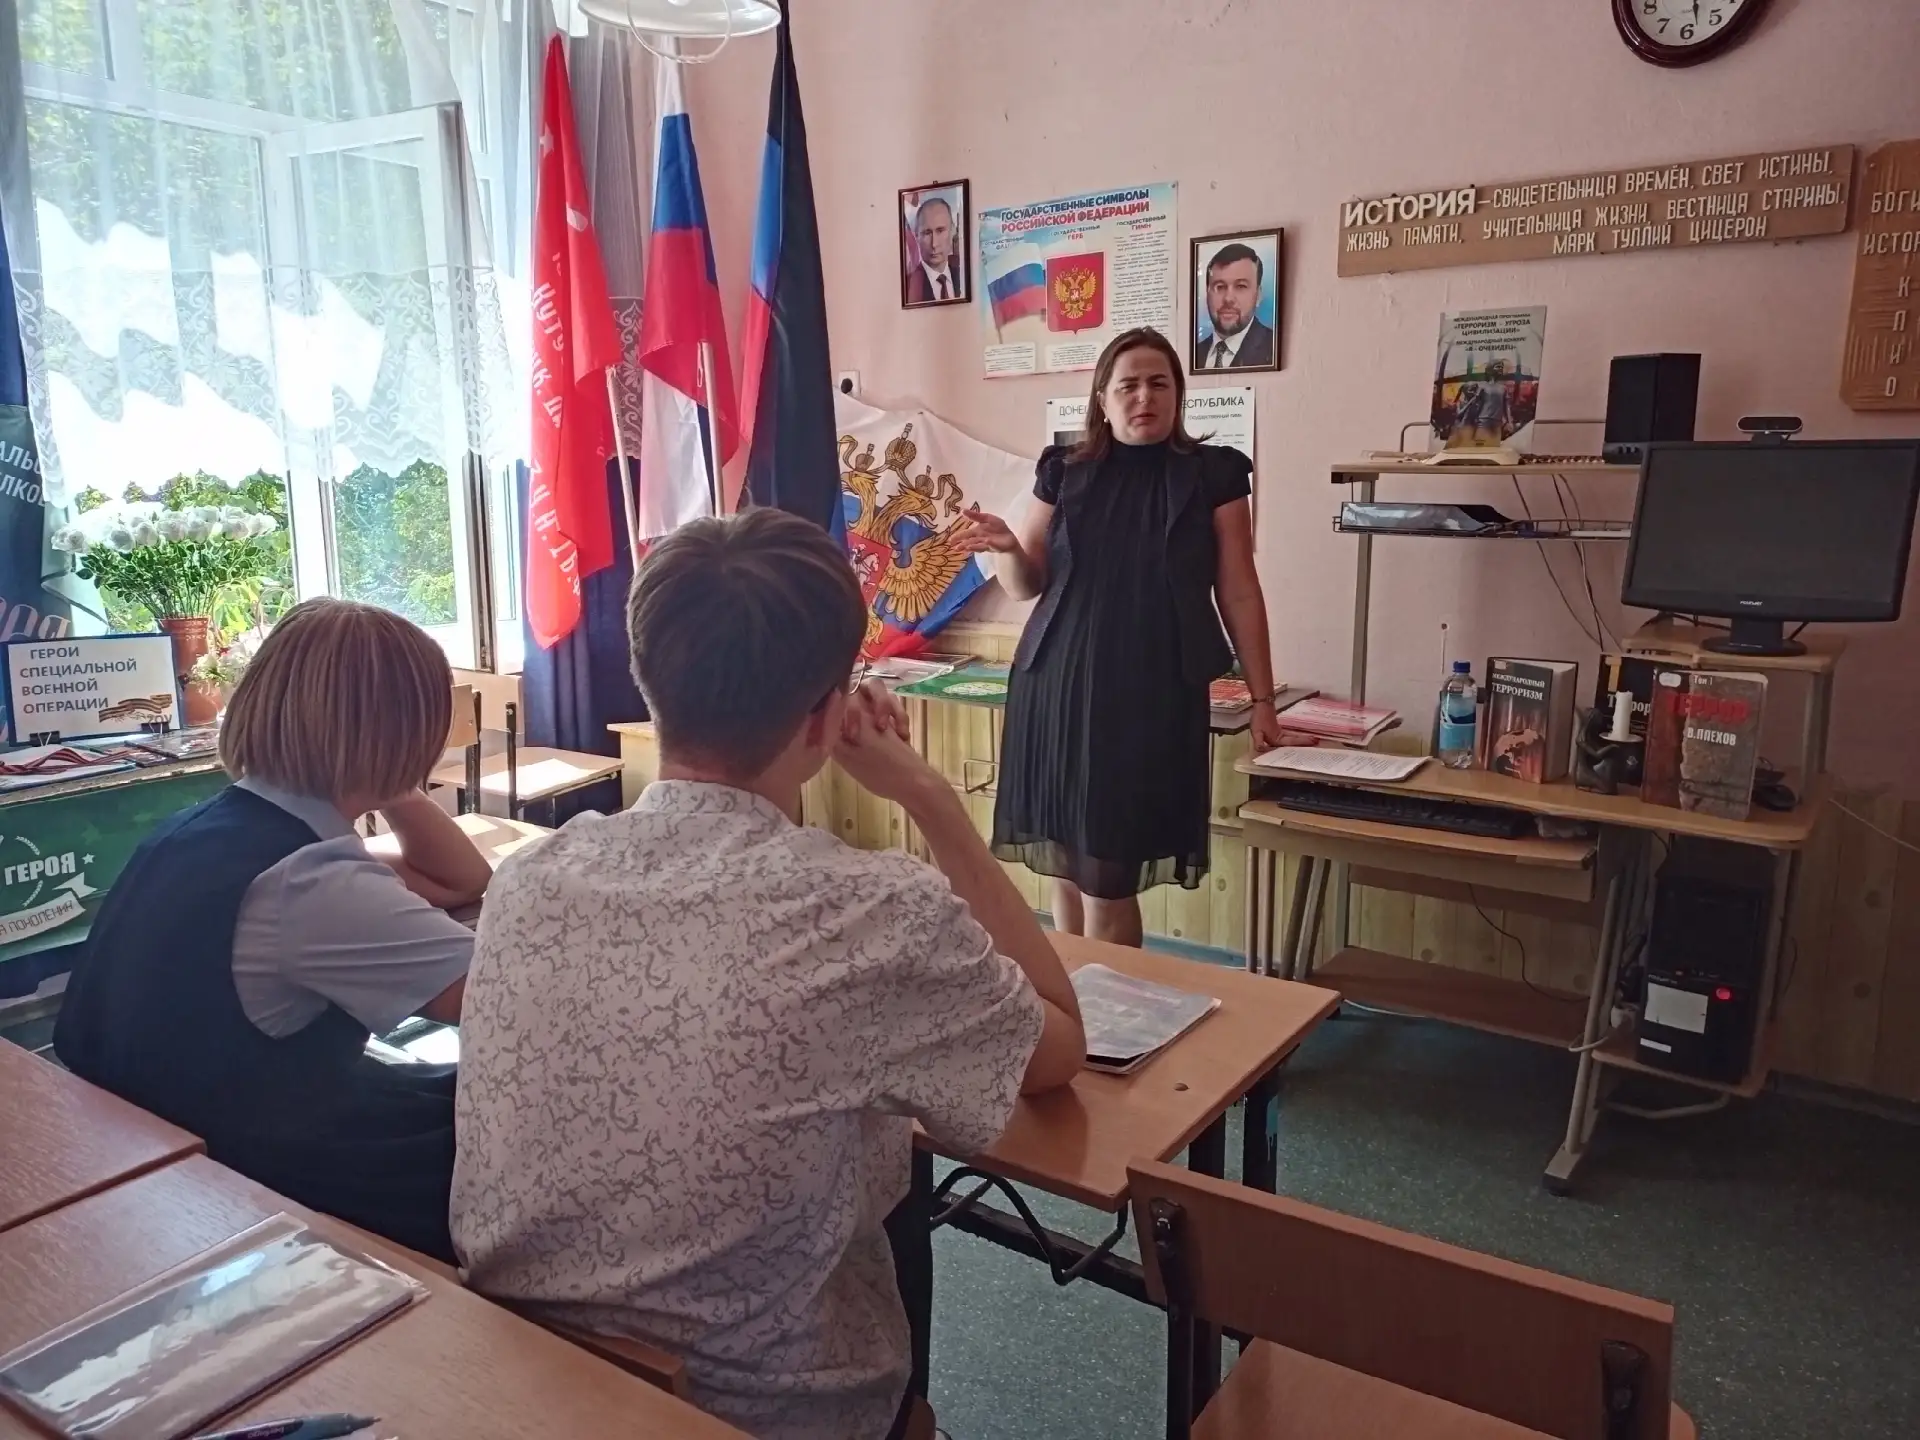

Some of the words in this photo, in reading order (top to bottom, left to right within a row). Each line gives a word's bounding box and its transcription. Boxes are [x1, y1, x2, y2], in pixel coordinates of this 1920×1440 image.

[1657, 18, 1671, 34] 7
[1709, 9, 1722, 26] 5
[1680, 23, 1694, 40] 6
[1344, 188, 1477, 228] ИСТОРИЯ
[1493, 174, 1617, 208] СВИДЕТЕЛЬНИЦА
[1625, 165, 1695, 193] ВРЕМЁН,
[1702, 162, 1744, 186] СВЕТ
[1759, 151, 1834, 179] ИСТИНЫ,
[1002, 198, 1095, 221] ГОСУДАРСТВЕННЫЕ
[1096, 189, 1149, 206] СИМВОЛЫ
[1002, 210, 1075, 234] РОССИЙСКОЙ
[1077, 201, 1150, 222] ФЕДЕРАЦИИ
[1132, 223, 1151, 231] ГИМН
[1347, 230, 1390, 252] ЖИЗНЬ
[1403, 222, 1464, 246] ПАМЯТИ,
[1483, 208, 1582, 239] УЧИТЕЛЬНИЦА
[1595, 203, 1651, 227] ЖИЗНИ,
[1667, 192, 1749, 221] ВЕСТНИЦА
[1762, 183, 1845, 211] СТАРИНЫ.
[1552, 232, 1596, 255] МАРК
[1612, 223, 1672, 249] ТУЛЛИЙ
[1689, 216, 1767, 243] ЦИЦЕРОН
[30, 647, 80, 660] ГЕРОИ
[20, 658, 137, 679] СПЕЦИАЛЬНОЙ
[22, 678, 98, 697] ВОЕННОЙ
[1492, 672, 1545, 688] МЕЖДУНАРОДНЫЙ
[1693, 675, 1707, 685] Том
[1492, 682, 1543, 701] ТЕРРОРИЗМ
[23, 697, 109, 714] ОПЕРАЦИИ
[4, 851, 76, 886] ГЕРОЯ
